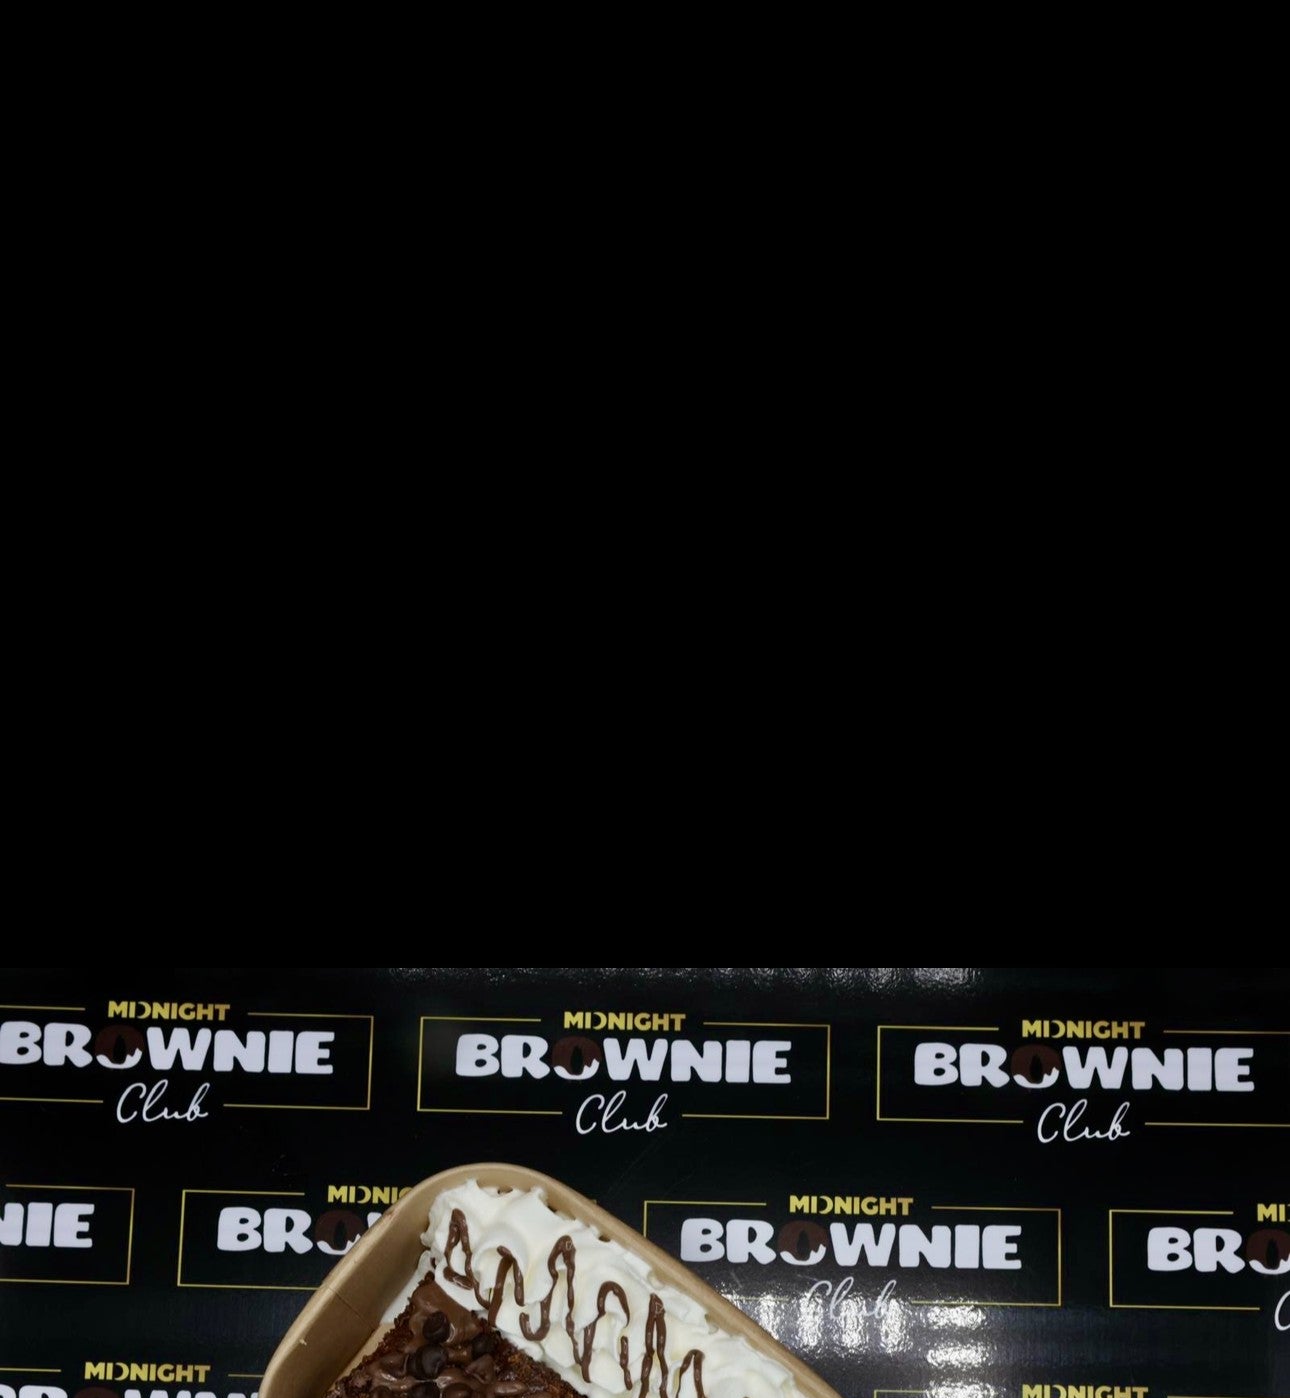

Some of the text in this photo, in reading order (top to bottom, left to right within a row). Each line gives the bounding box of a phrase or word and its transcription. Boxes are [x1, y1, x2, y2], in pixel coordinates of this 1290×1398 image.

[108, 1000, 231, 1021] MIDNIGHT
[564, 1011, 686, 1031] MIDNIGHT
[1021, 1019, 1146, 1039] MIDNIGHT
[0, 1021, 335, 1075] BROWNIE
[455, 1033, 792, 1084] BROWNIE
[914, 1042, 1254, 1092] BROWNIE
[116, 1079, 210, 1123] Club
[575, 1090, 668, 1134] Club
[1037, 1099, 1130, 1143] Club
[327, 1185, 412, 1205] MIDNI
[789, 1195, 914, 1216] MIDNIGHT
[217, 1206, 383, 1256] BRO
[680, 1218, 1022, 1270] BROWNIE
[84, 1361, 211, 1383] MIDNIGHT
